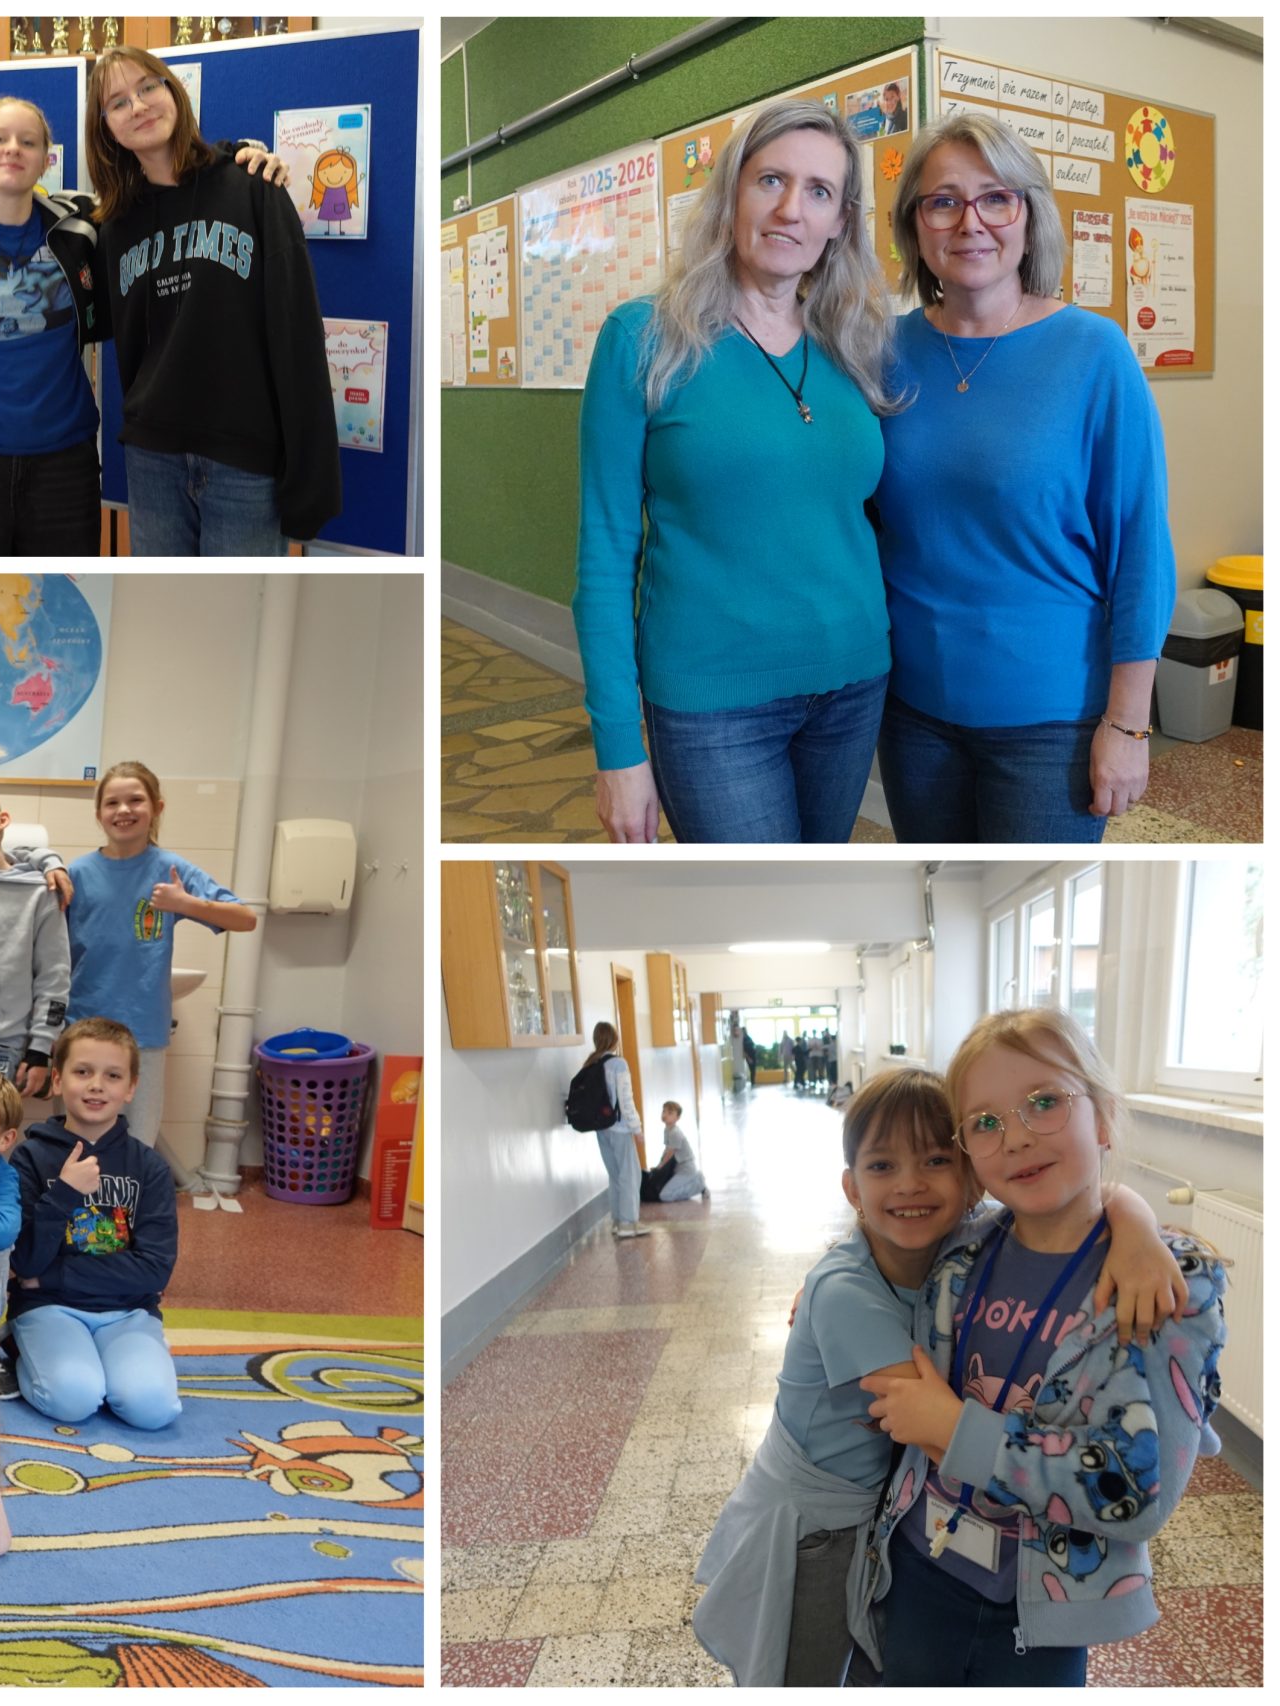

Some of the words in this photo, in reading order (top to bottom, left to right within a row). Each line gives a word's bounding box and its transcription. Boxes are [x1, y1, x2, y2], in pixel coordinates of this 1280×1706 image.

[944, 61, 995, 92] Trzymanie
[1021, 87, 1047, 103] razem
[1055, 91, 1065, 105] to
[1018, 125, 1045, 140] razem
[1055, 129, 1065, 143] to
[580, 152, 656, 198] 2025-2026
[1056, 165, 1092, 185] sukces!
[173, 220, 254, 280] TIMES
